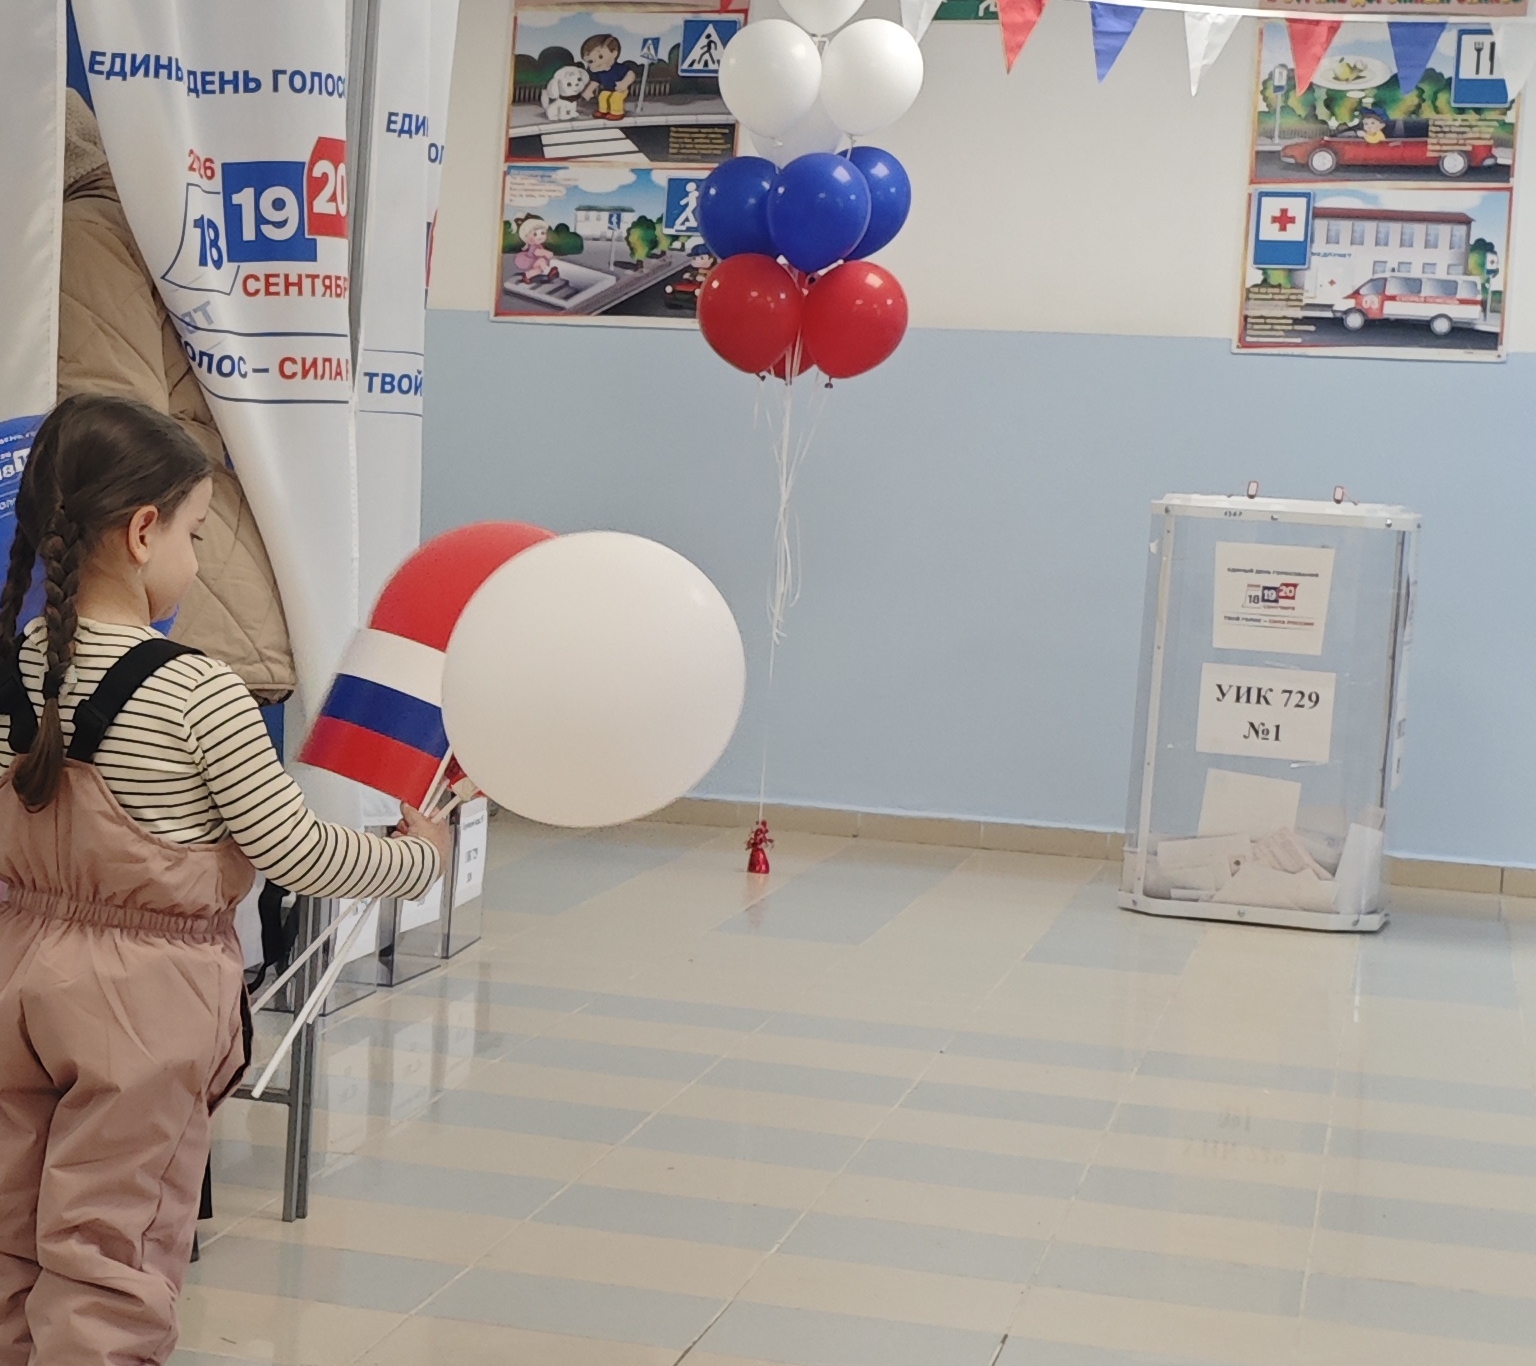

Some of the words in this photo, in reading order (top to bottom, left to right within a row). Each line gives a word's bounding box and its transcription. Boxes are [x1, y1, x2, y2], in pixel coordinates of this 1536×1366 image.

[187, 70, 262, 98] ДЕНЬ
[312, 159, 347, 217] 20
[231, 185, 299, 241] 19
[193, 214, 223, 270] 18
[278, 356, 344, 381] СИЛА
[363, 369, 423, 397] ТВОЙ
[1278, 585, 1296, 597] 20
[1215, 683, 1274, 706] УИК
[1281, 689, 1320, 710] 729
[1243, 721, 1281, 742] №1
